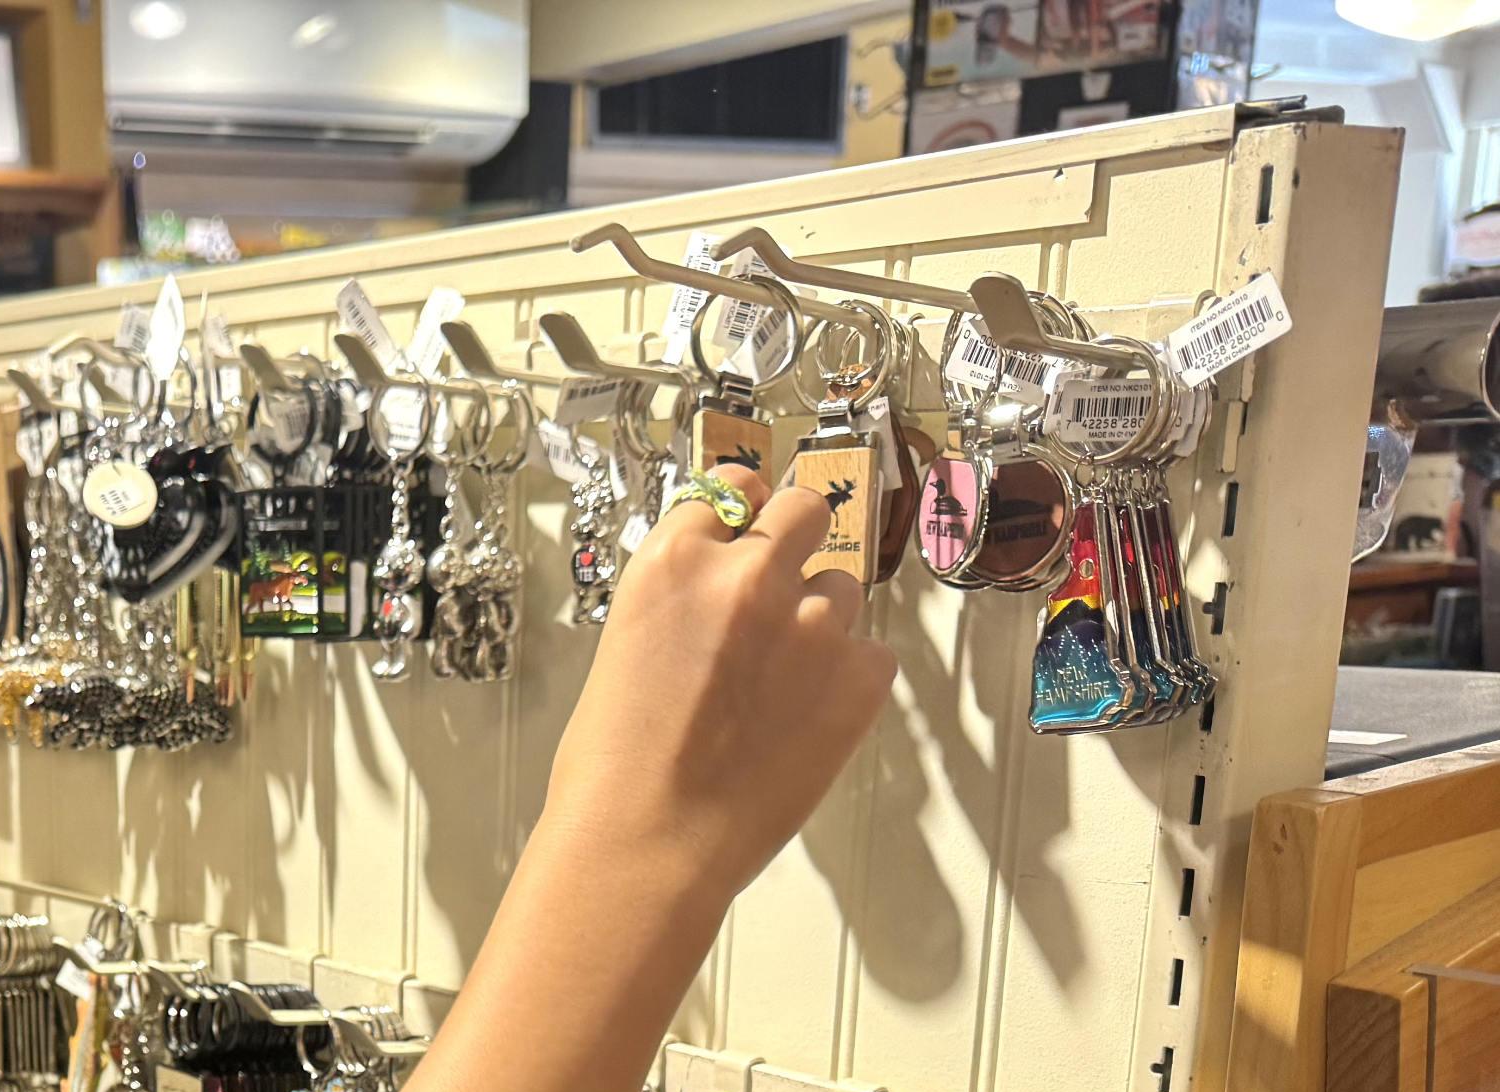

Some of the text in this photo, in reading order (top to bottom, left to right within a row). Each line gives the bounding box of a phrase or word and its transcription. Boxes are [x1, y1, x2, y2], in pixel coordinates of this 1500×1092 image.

[1190, 293, 1249, 333] ITEM NO NKC1010
[1194, 345, 1228, 370] 42258
[1230, 322, 1265, 350] 28000
[1275, 310, 1285, 322] 0
[1206, 359, 1224, 373] MADE
[1232, 343, 1251, 359] CHINA
[1090, 384, 1152, 393] ITEM NO NKC101
[1065, 418, 1146, 431] 7 42258 280
[1088, 431, 1107, 439] MADE
[819, 541, 861, 553] PSHIRE
[1056, 665, 1088, 683] NEW
[1035, 680, 1113, 705] HAMPSHIRE
